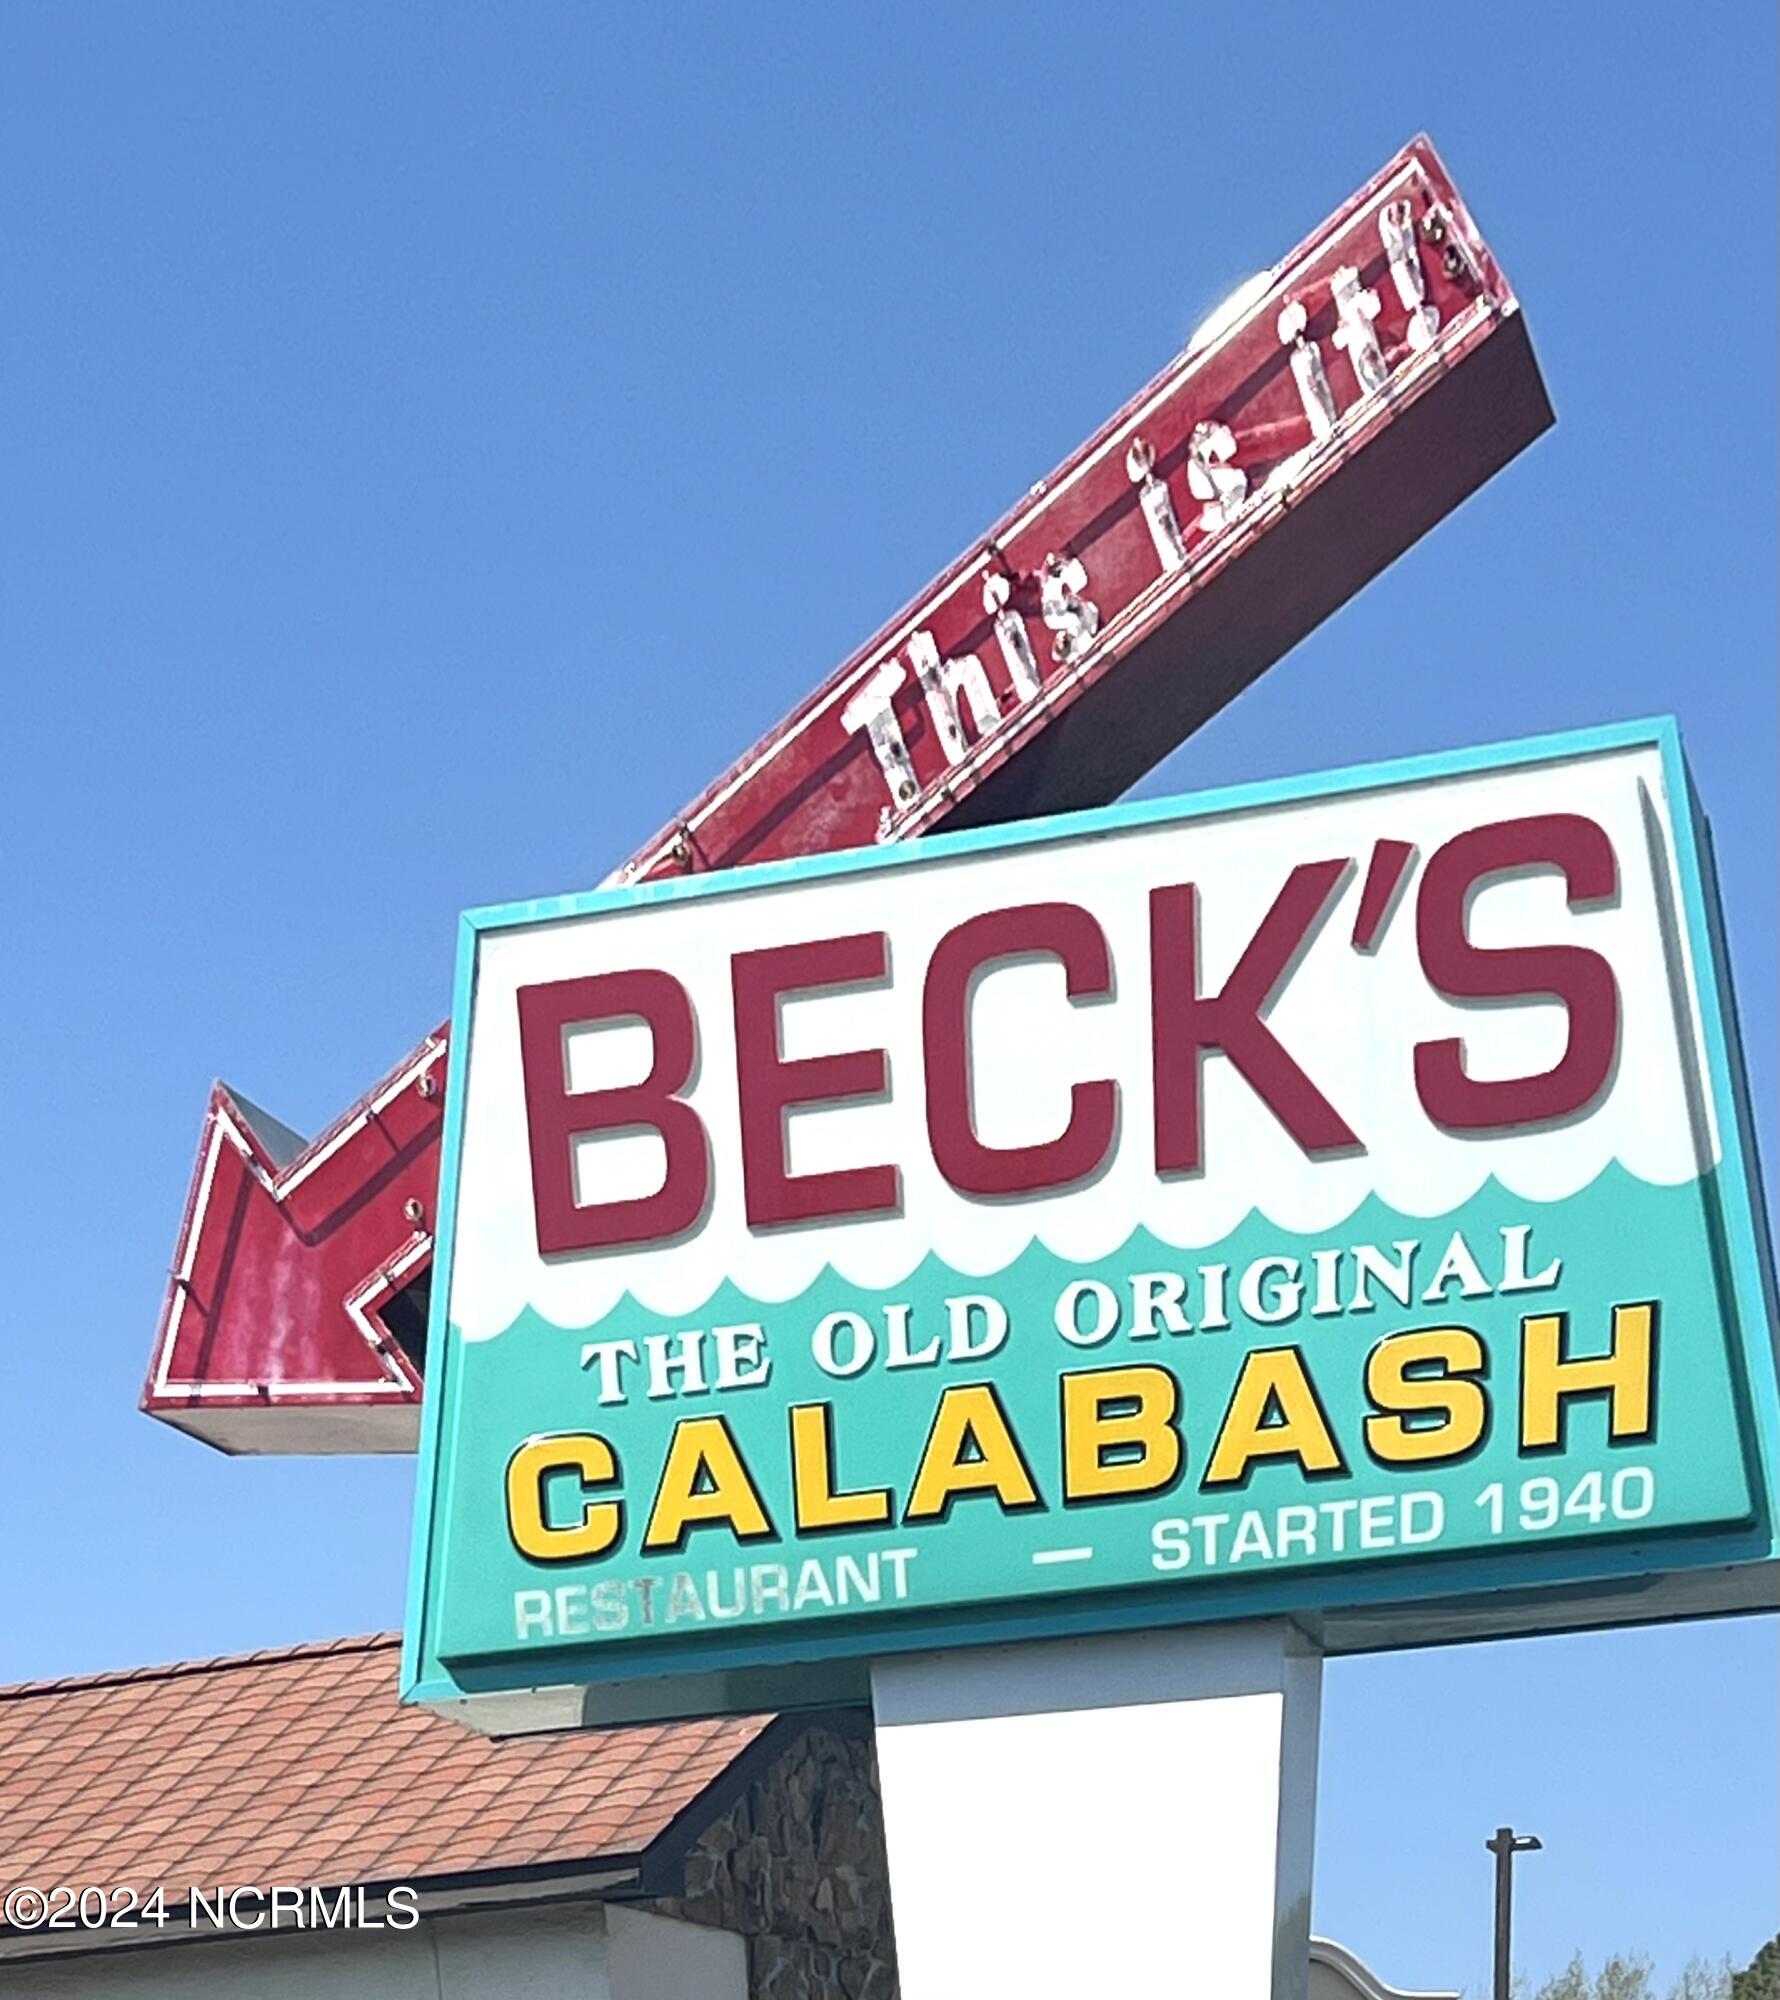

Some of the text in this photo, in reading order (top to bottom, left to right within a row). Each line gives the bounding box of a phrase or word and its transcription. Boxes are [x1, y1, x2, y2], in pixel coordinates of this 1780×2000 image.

[841, 199, 1441, 803] This is it!
[516, 812, 1621, 1262] BECK'S
[505, 1300, 1661, 1564] CALABASH
[580, 1225, 1562, 1404] THE OLD ORIGINAL
[514, 1548, 918, 1639] RESTAURANT
[1151, 1491, 1445, 1571] STARTED
[1475, 1466, 1655, 1534] 1940
